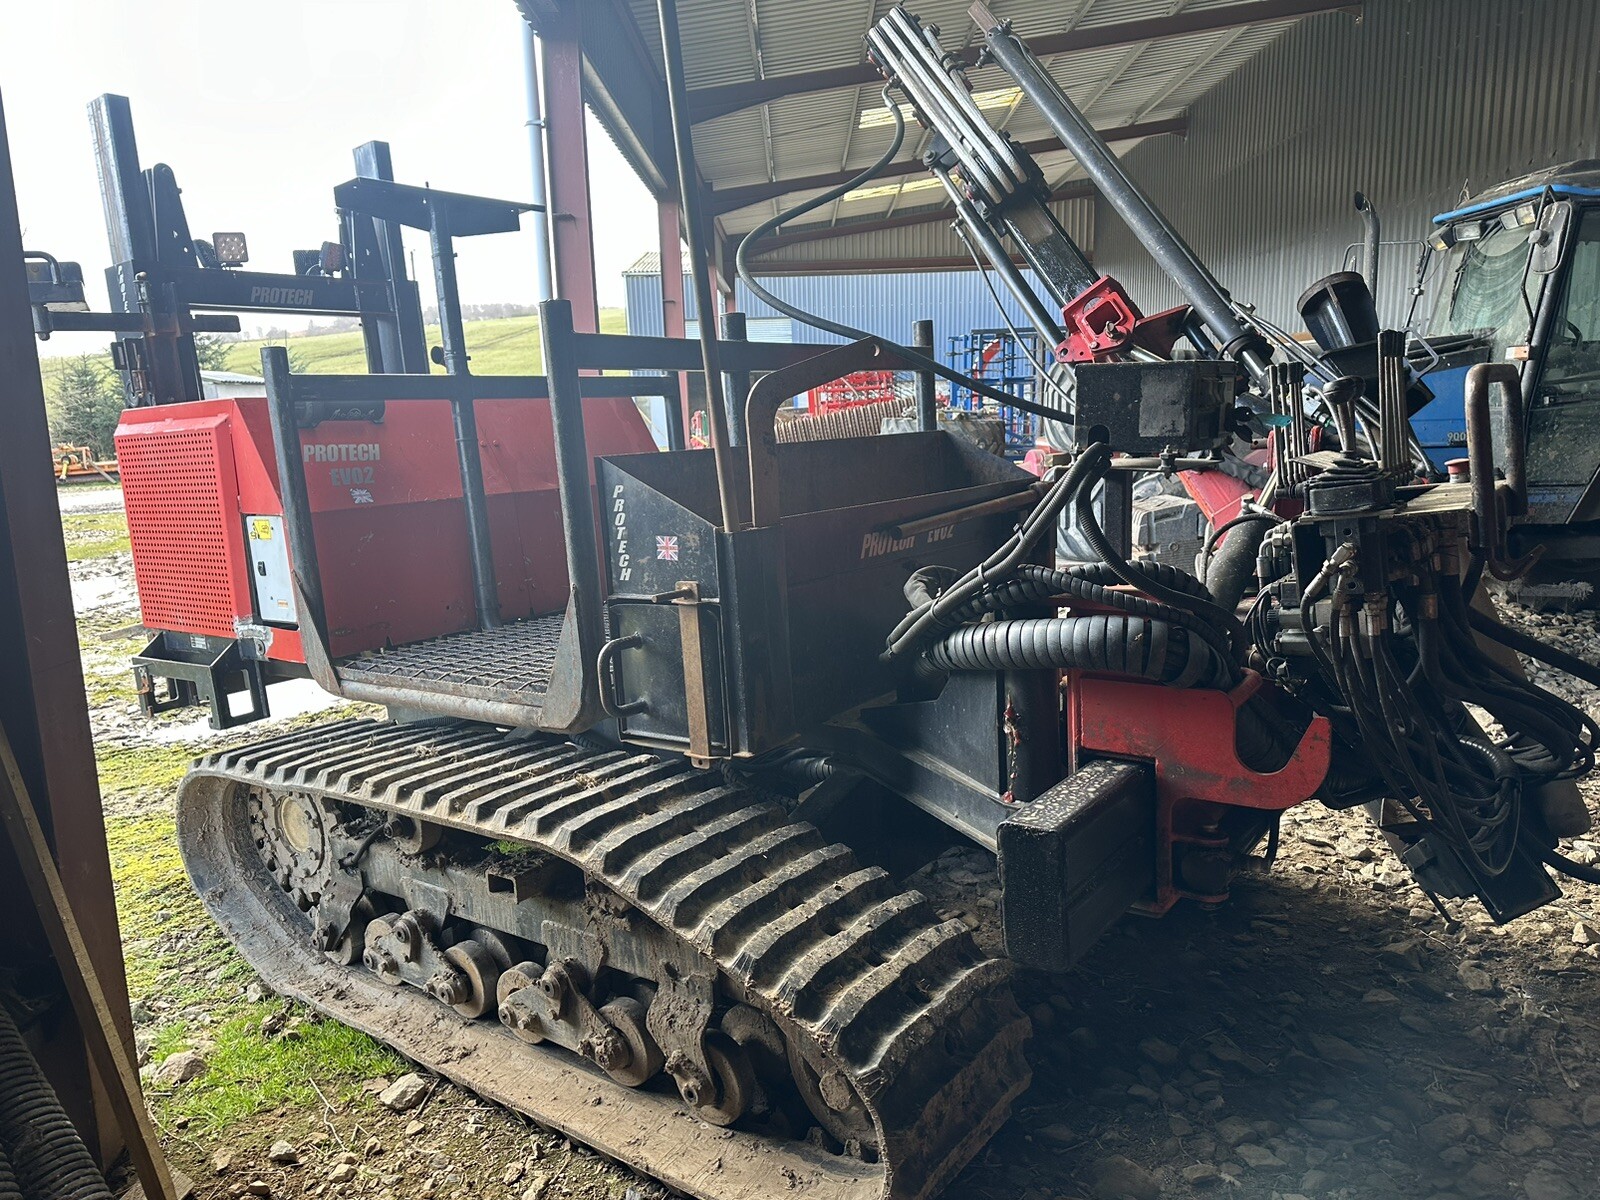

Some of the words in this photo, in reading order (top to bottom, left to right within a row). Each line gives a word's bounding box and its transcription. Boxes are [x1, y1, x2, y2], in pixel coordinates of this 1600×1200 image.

[250, 286, 314, 305] PROTECH
[303, 443, 380, 463] PROTECH
[612, 485, 632, 581] PROTECH
